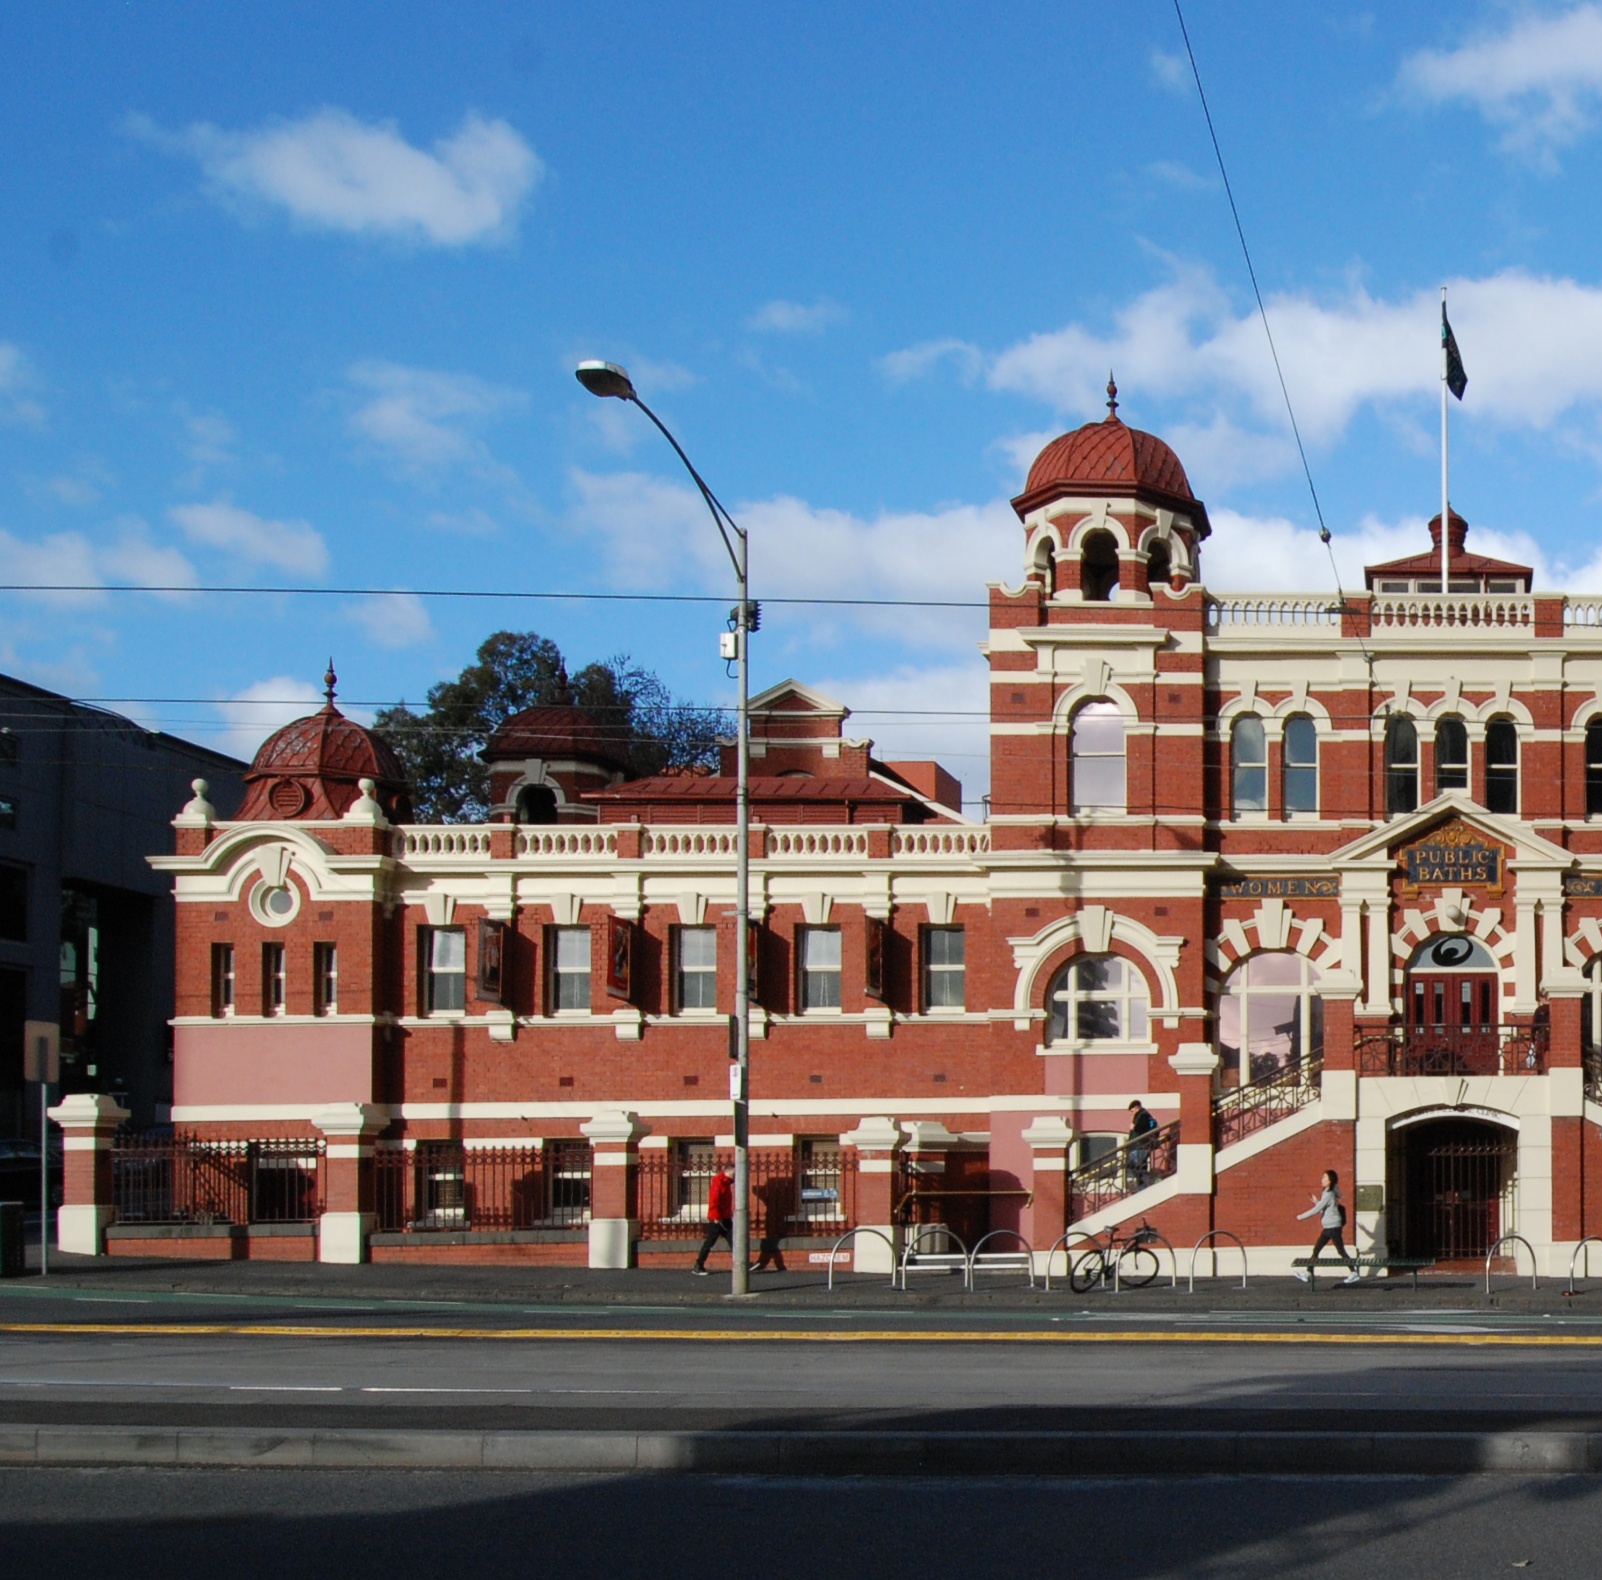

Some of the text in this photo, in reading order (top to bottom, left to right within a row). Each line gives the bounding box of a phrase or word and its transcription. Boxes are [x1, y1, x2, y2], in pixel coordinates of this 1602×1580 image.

[1416, 850, 1489, 863] PUBLIC
[1419, 866, 1487, 880] BATHS
[1230, 881, 1317, 894] WOMEN
